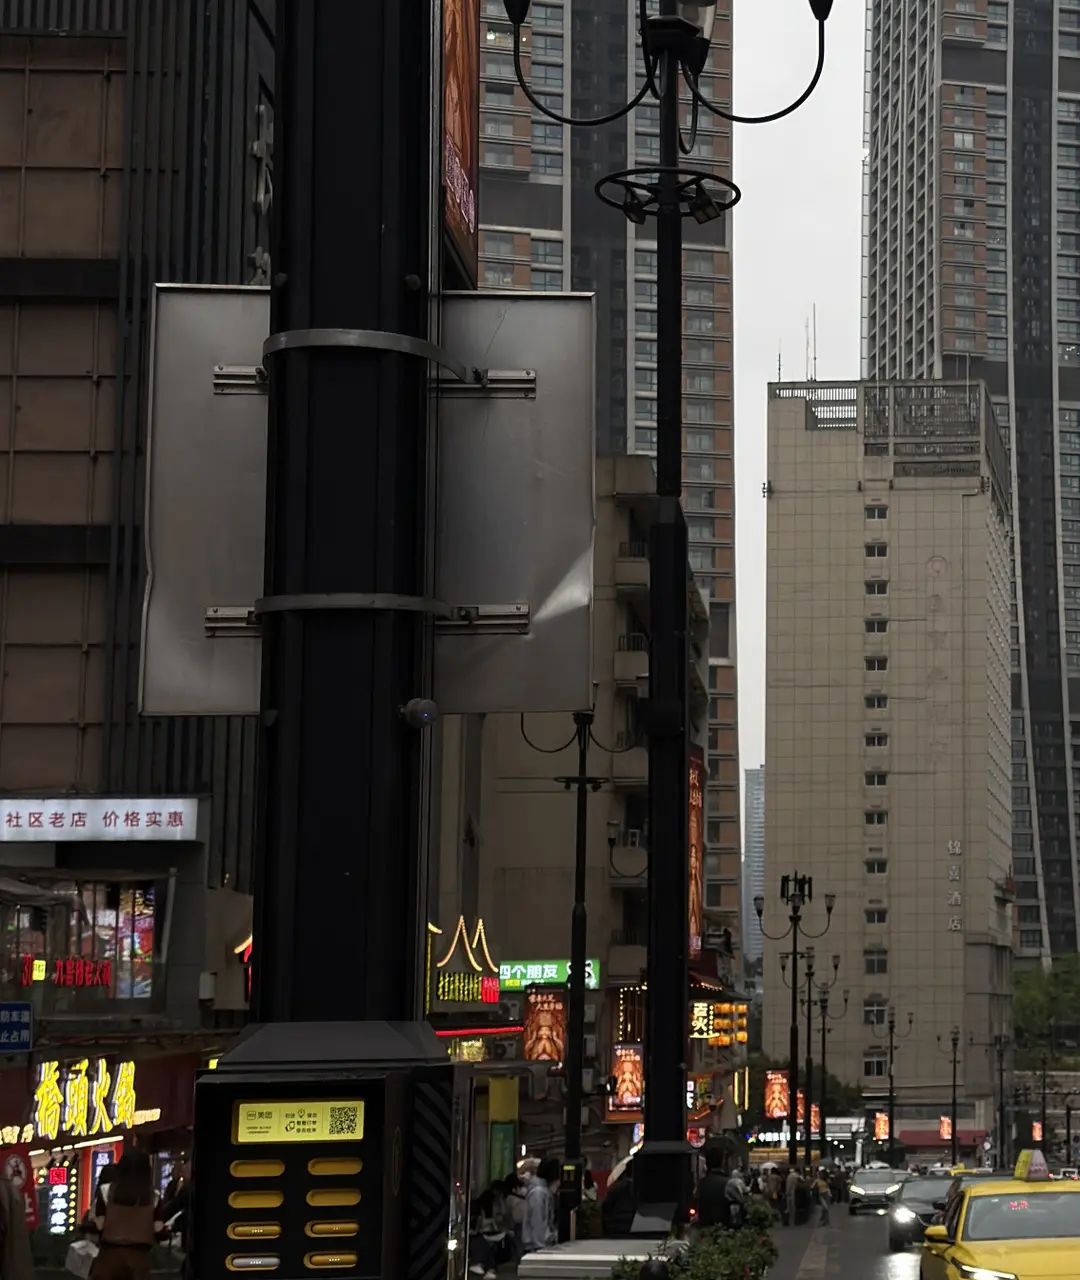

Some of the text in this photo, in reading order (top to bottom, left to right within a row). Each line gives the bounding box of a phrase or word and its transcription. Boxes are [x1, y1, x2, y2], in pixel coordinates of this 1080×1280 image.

[6, 811, 185, 828] 社区老店 价格实惠
[499, 964, 558, 979] 四个朋友
[35, 1057, 137, 1140] 橋頭火鍋
